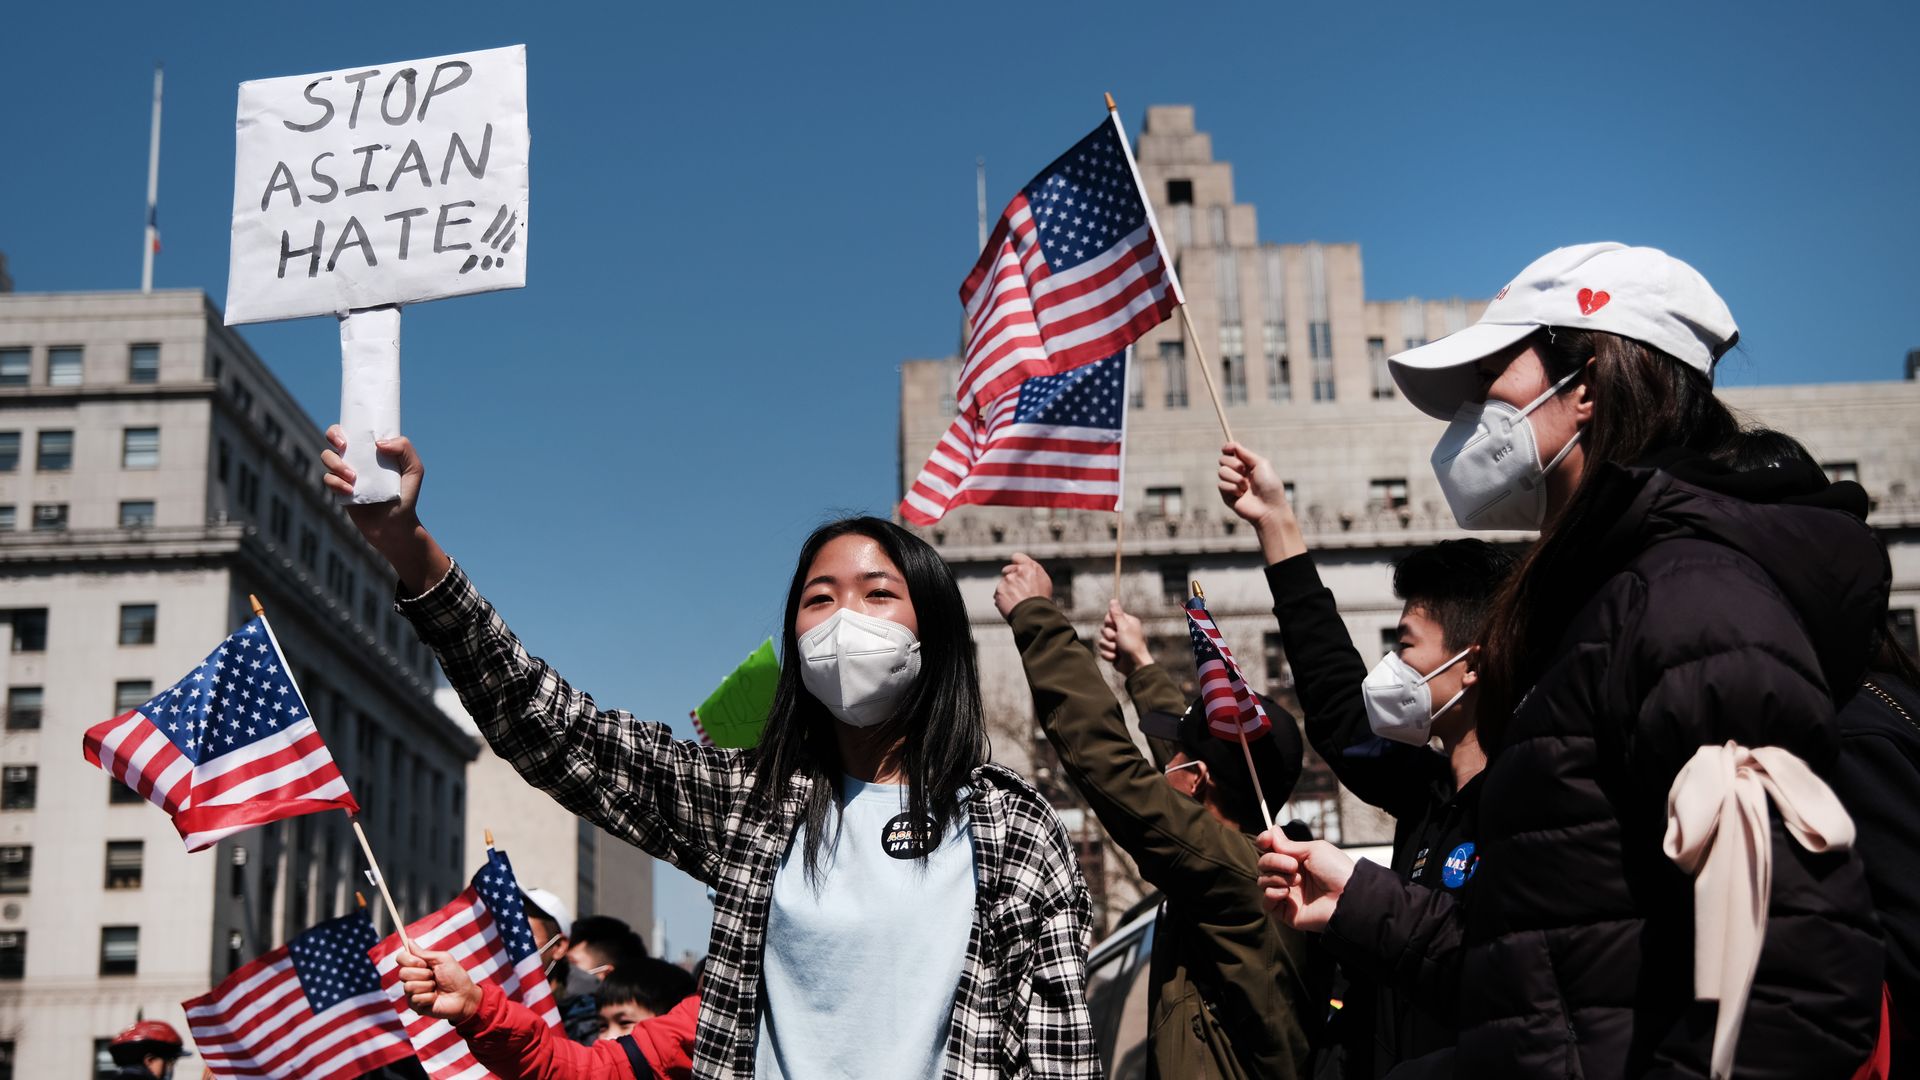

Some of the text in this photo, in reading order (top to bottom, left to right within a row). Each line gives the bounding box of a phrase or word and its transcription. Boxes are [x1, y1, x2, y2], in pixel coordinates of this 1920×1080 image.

[283, 61, 473, 132] STOP
[261, 123, 493, 212] ASIAN
[892, 821, 932, 830] STP
